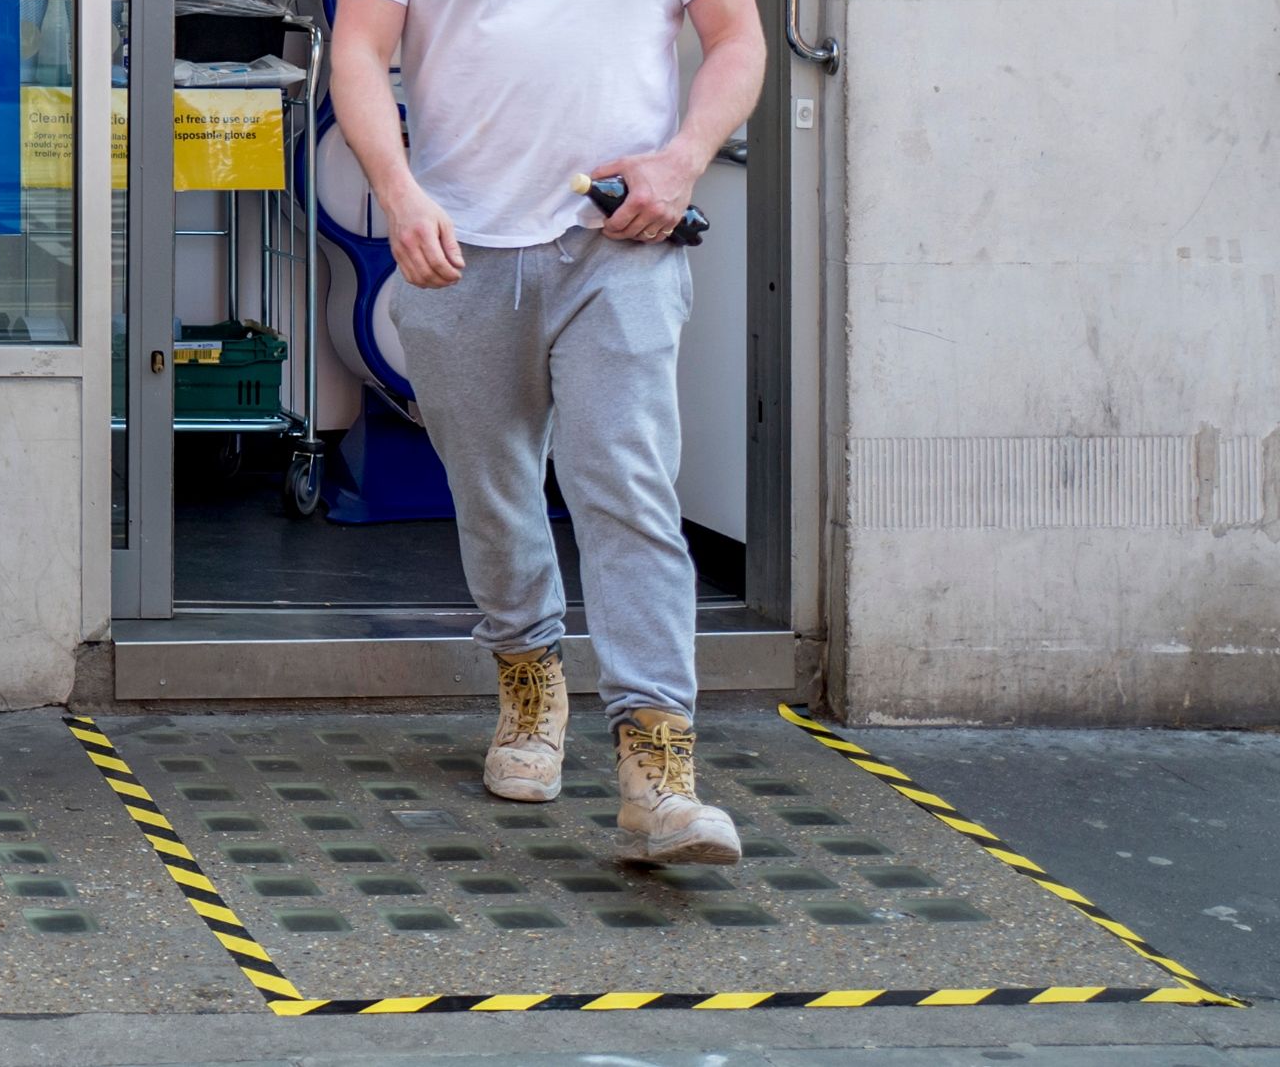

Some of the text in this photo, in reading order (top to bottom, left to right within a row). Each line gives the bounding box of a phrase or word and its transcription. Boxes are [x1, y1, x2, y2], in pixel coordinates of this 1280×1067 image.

[186, 114, 260, 124] free to use our
[175, 130, 256, 141] isposable gloves
